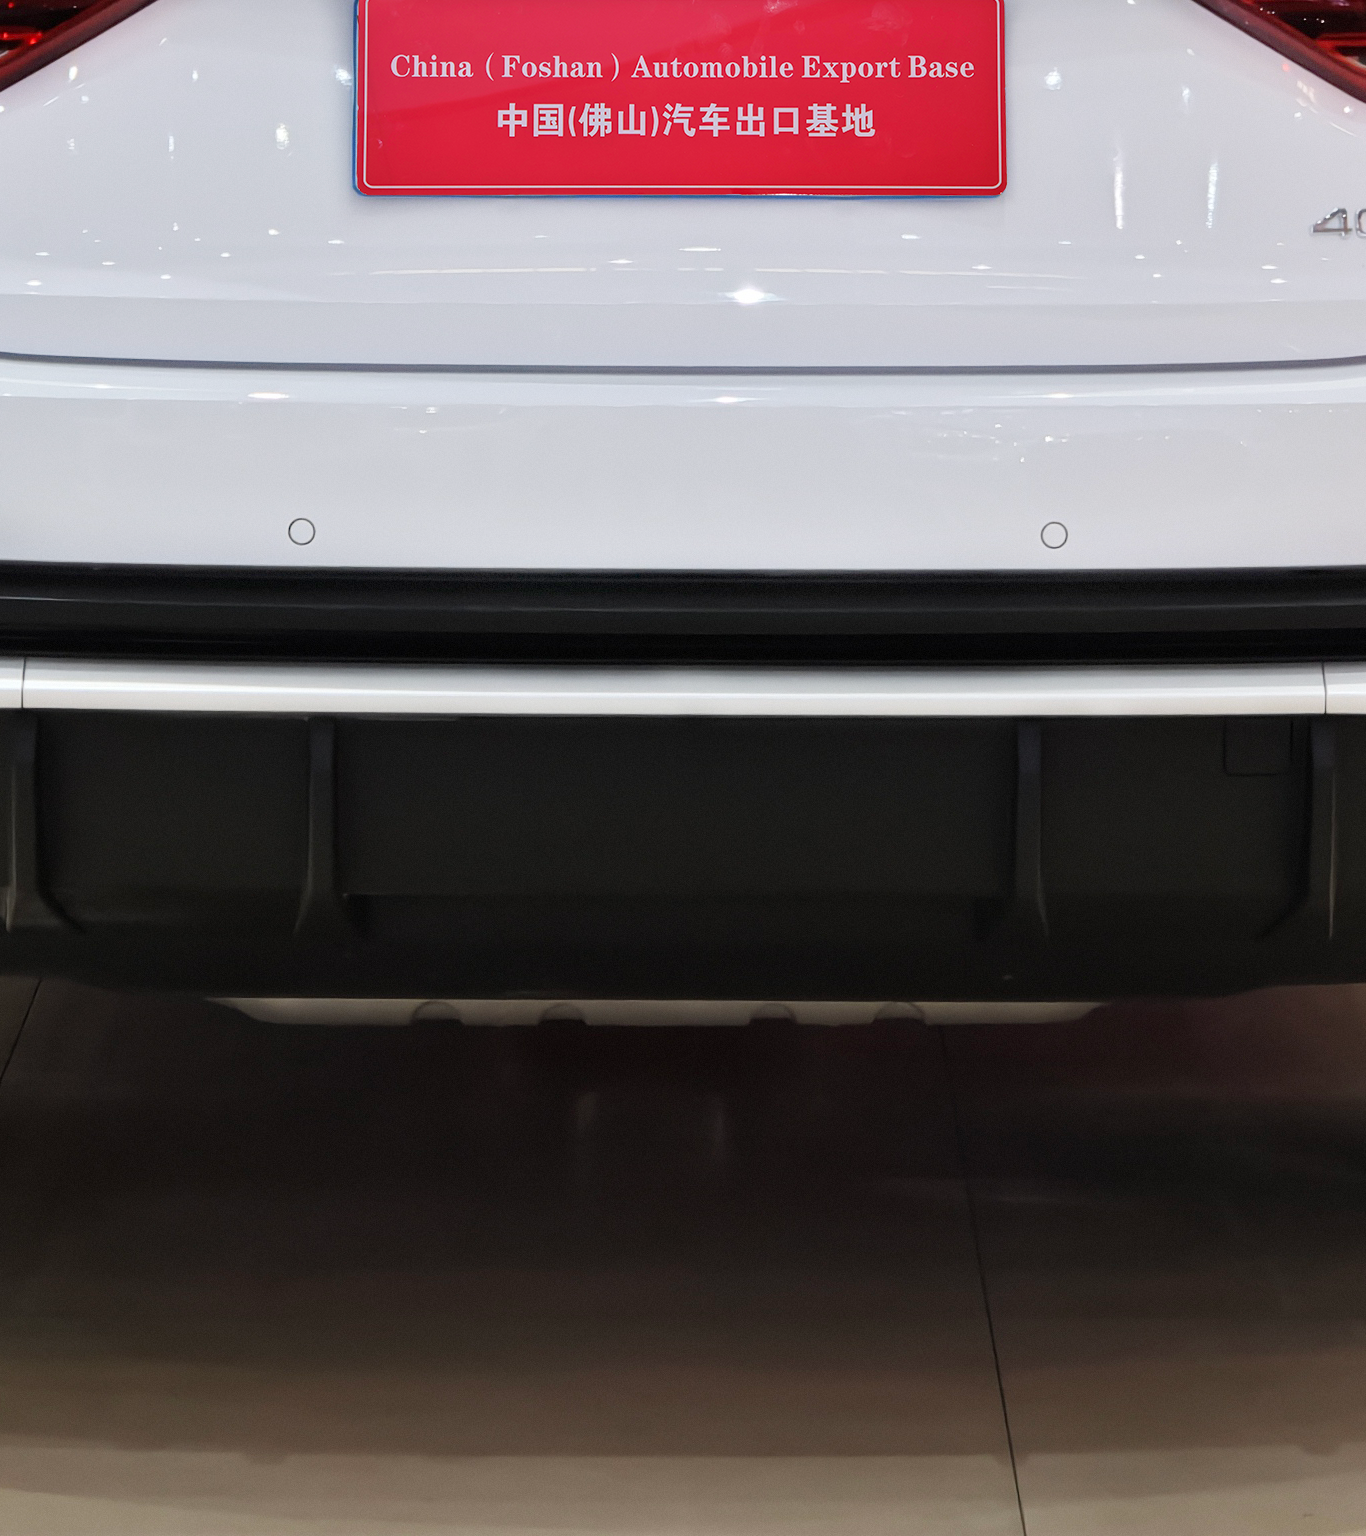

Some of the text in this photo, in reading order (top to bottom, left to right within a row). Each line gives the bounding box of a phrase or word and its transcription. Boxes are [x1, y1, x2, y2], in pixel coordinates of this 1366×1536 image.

[390, 54, 474, 80] China
[631, 54, 795, 80] Automobile
[801, 54, 901, 85] Export
[908, 54, 975, 80] Base
[496, 101, 877, 139] 中国(佛山)汽车出口基地
